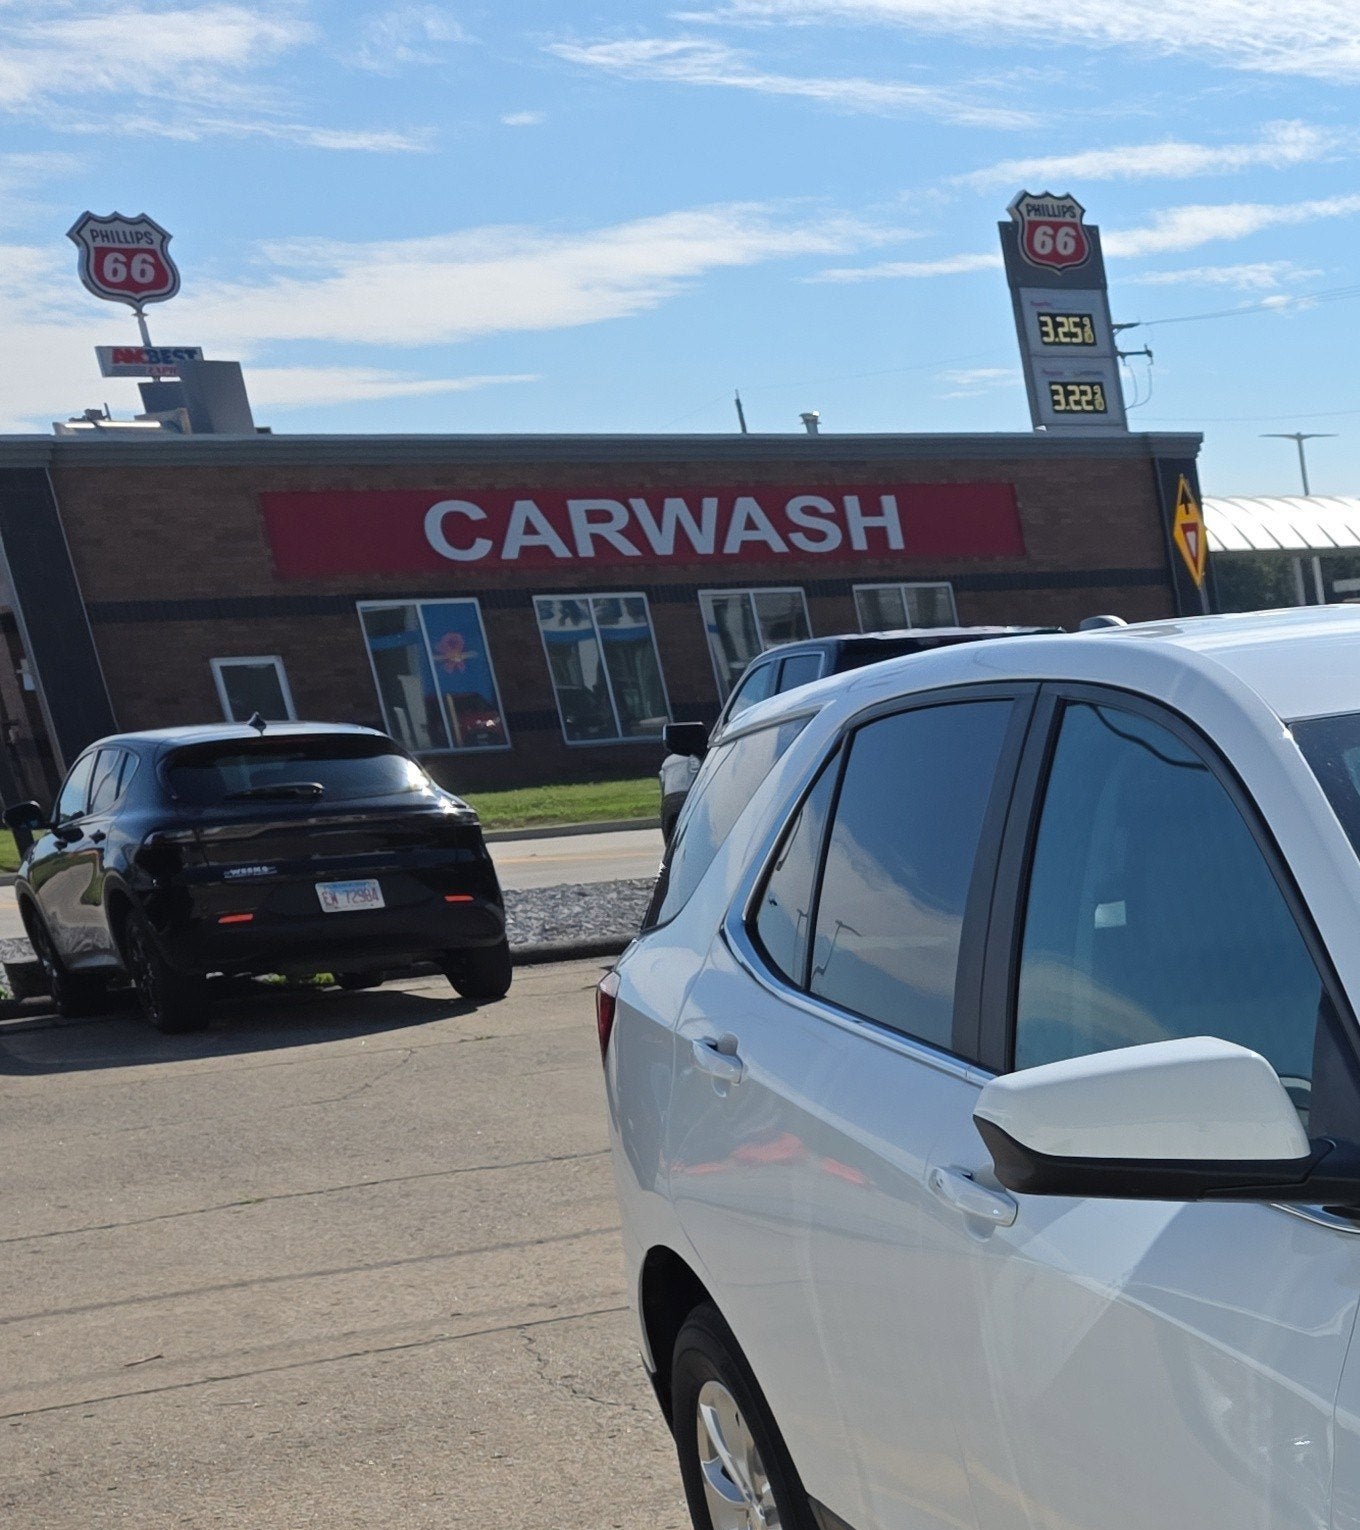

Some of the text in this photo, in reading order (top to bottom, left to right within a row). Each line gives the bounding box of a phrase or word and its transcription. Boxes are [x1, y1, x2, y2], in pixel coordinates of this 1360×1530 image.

[1025, 203, 1076, 218] PHILLIPS
[90, 229, 154, 245] PHILLIPS
[1033, 225, 1077, 256] 66
[102, 252, 156, 284] 66
[422, 494, 905, 563] CARWASH
